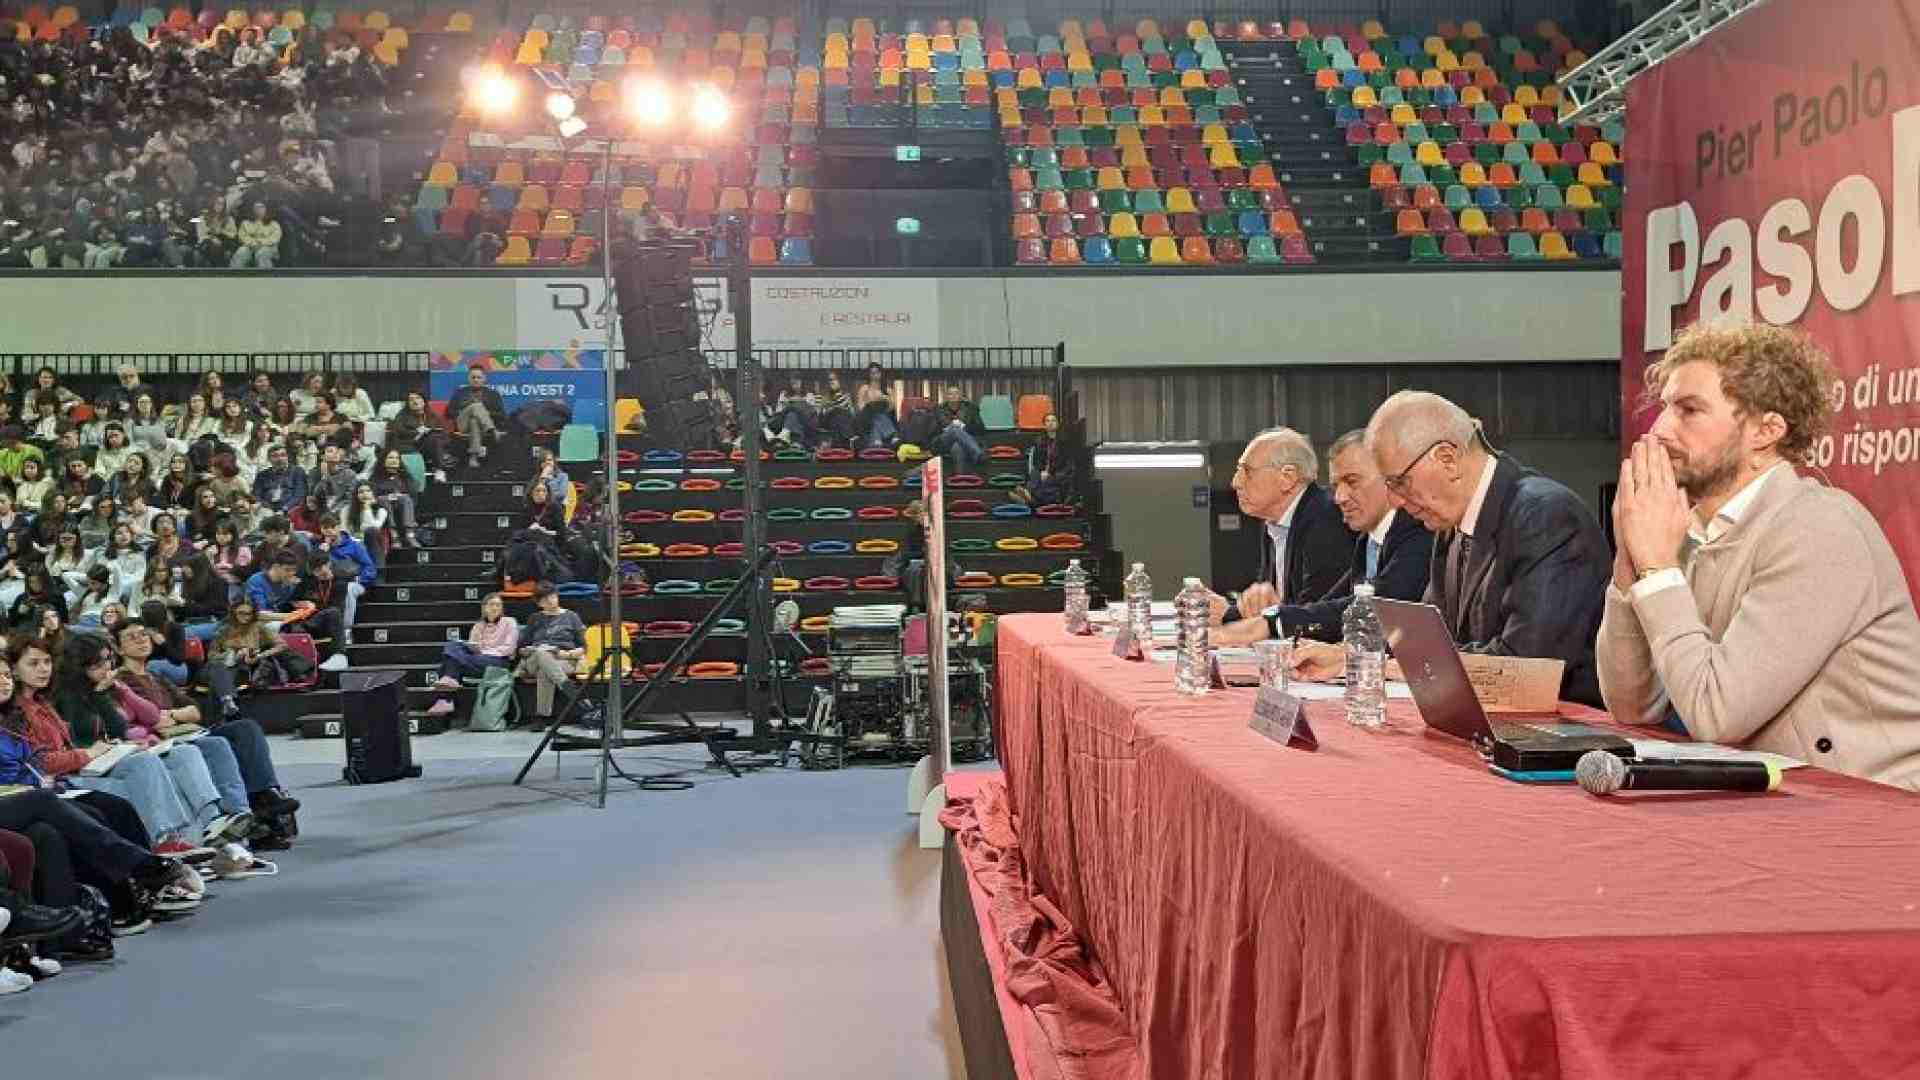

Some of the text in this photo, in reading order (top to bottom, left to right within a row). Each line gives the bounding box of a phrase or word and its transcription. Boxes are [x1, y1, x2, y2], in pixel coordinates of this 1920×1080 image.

[1696, 59, 1889, 190] Pier Paolo
[1644, 103, 1920, 352] Paso
[521, 384, 564, 396] OVEST
[567, 384, 576, 396] 2
[1853, 362, 1880, 411] di
[1806, 435, 1834, 468] so
